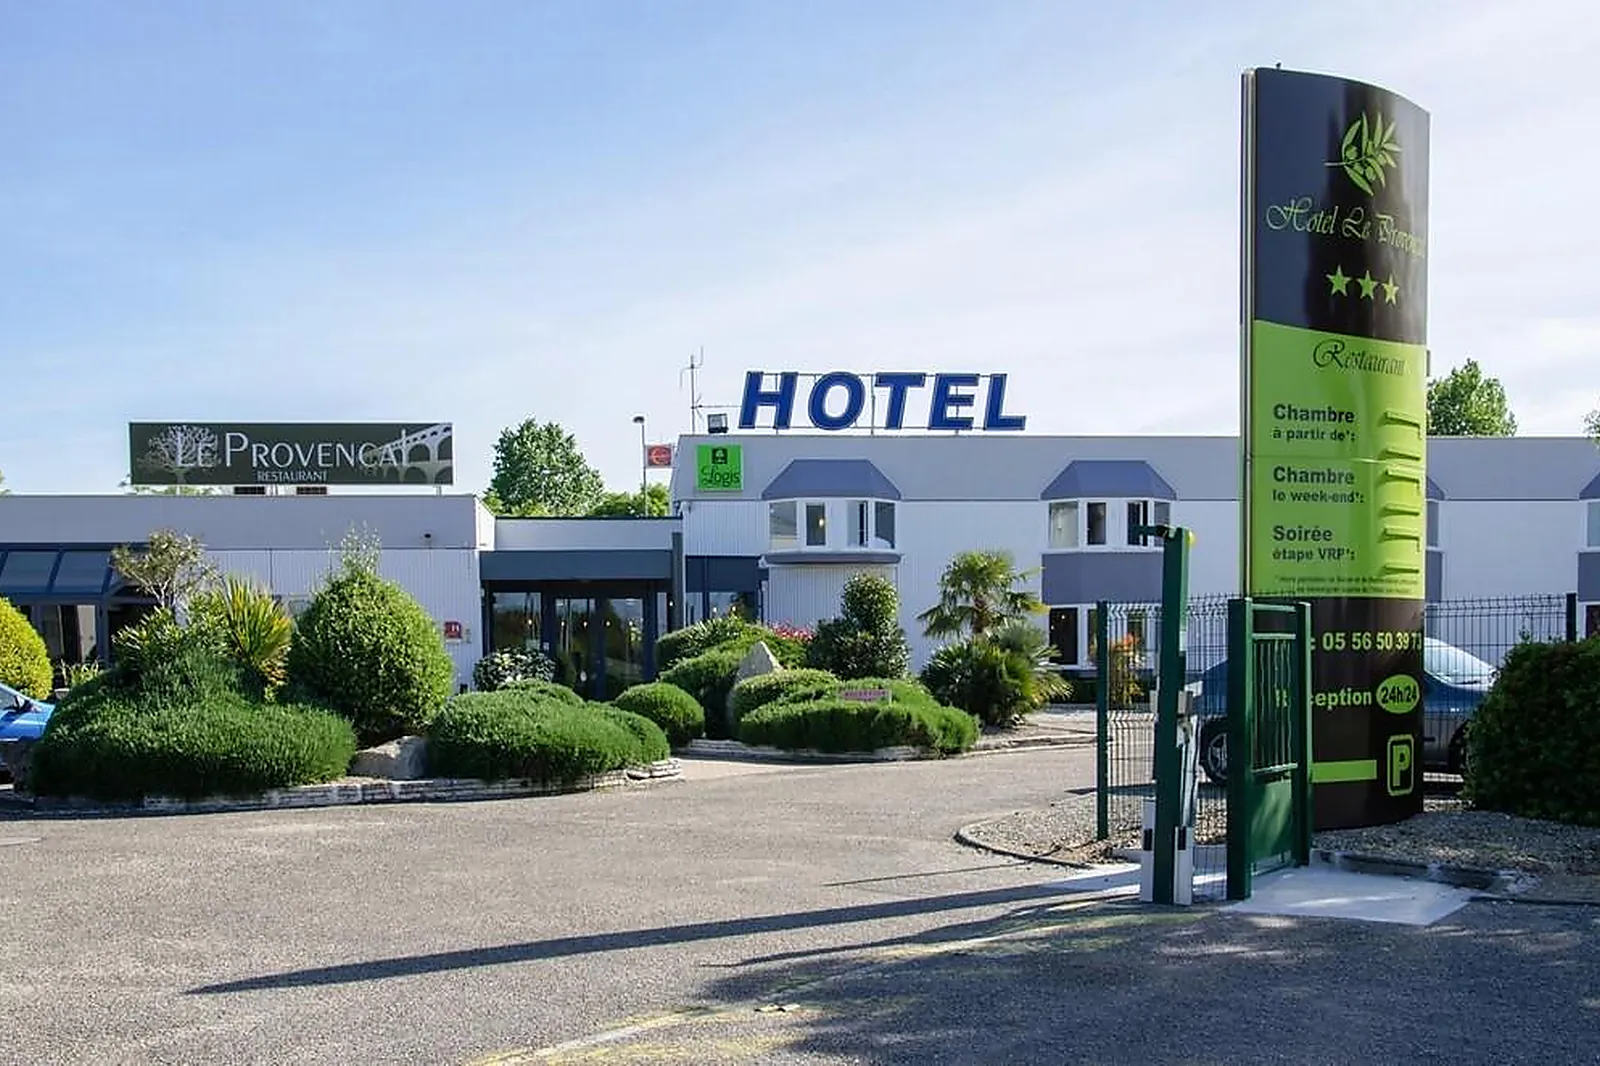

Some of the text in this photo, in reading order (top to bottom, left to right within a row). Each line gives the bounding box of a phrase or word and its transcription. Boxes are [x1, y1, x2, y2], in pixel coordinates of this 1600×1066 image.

[1266, 197, 1338, 235] Hotel
[1342, 207, 1371, 240] Le
[738, 371, 1026, 430] HOTEL
[1273, 404, 1355, 423] Chambre
[1286, 428, 1325, 443] partir
[257, 470, 328, 482] RESTAURANT
[1273, 466, 1355, 485] Chambre
[1272, 489, 1286, 502] le
[1273, 525, 1333, 542] Soirée
[1272, 547, 1313, 562] étape
[1322, 632, 1346, 651] 05
[1351, 632, 1372, 651] 56
[1376, 632, 1393, 651] 50
[1395, 632, 1410, 651] 39
[1311, 688, 1373, 711] eption
